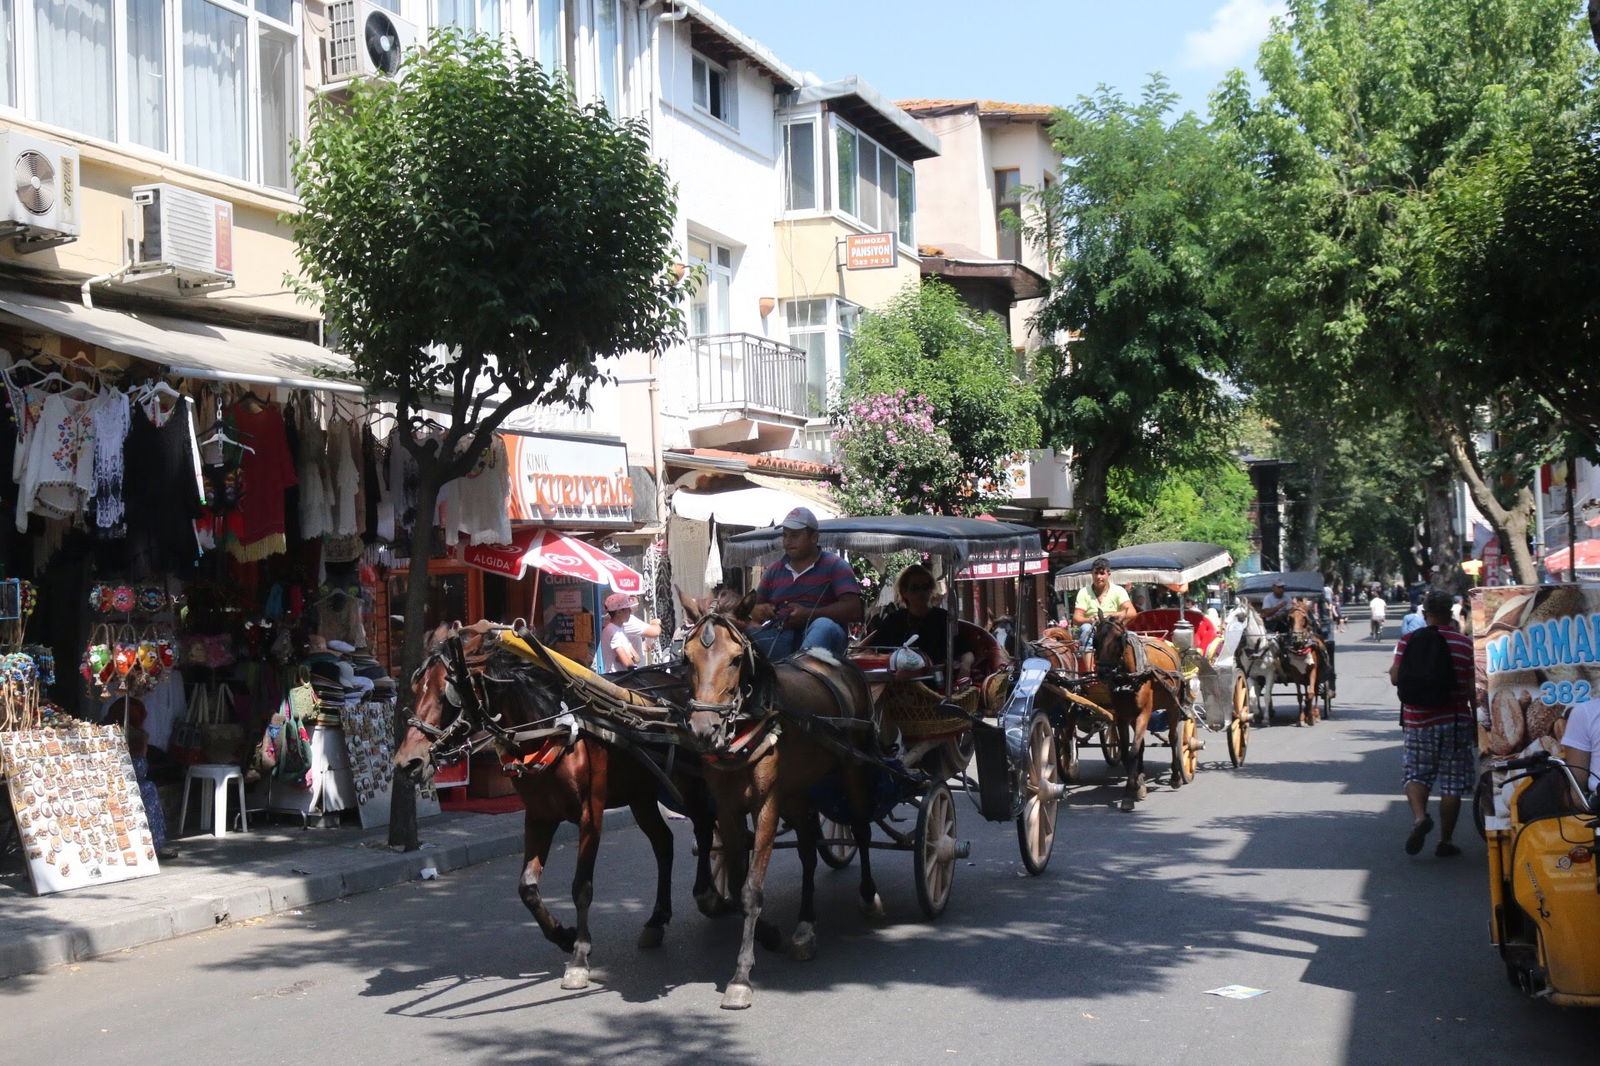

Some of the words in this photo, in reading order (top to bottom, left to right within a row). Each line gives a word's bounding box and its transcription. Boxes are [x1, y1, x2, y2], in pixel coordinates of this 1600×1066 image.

[526, 453, 550, 472] KINIK
[473, 553, 512, 571] ALGIDA
[1541, 681, 1591, 705] 382
